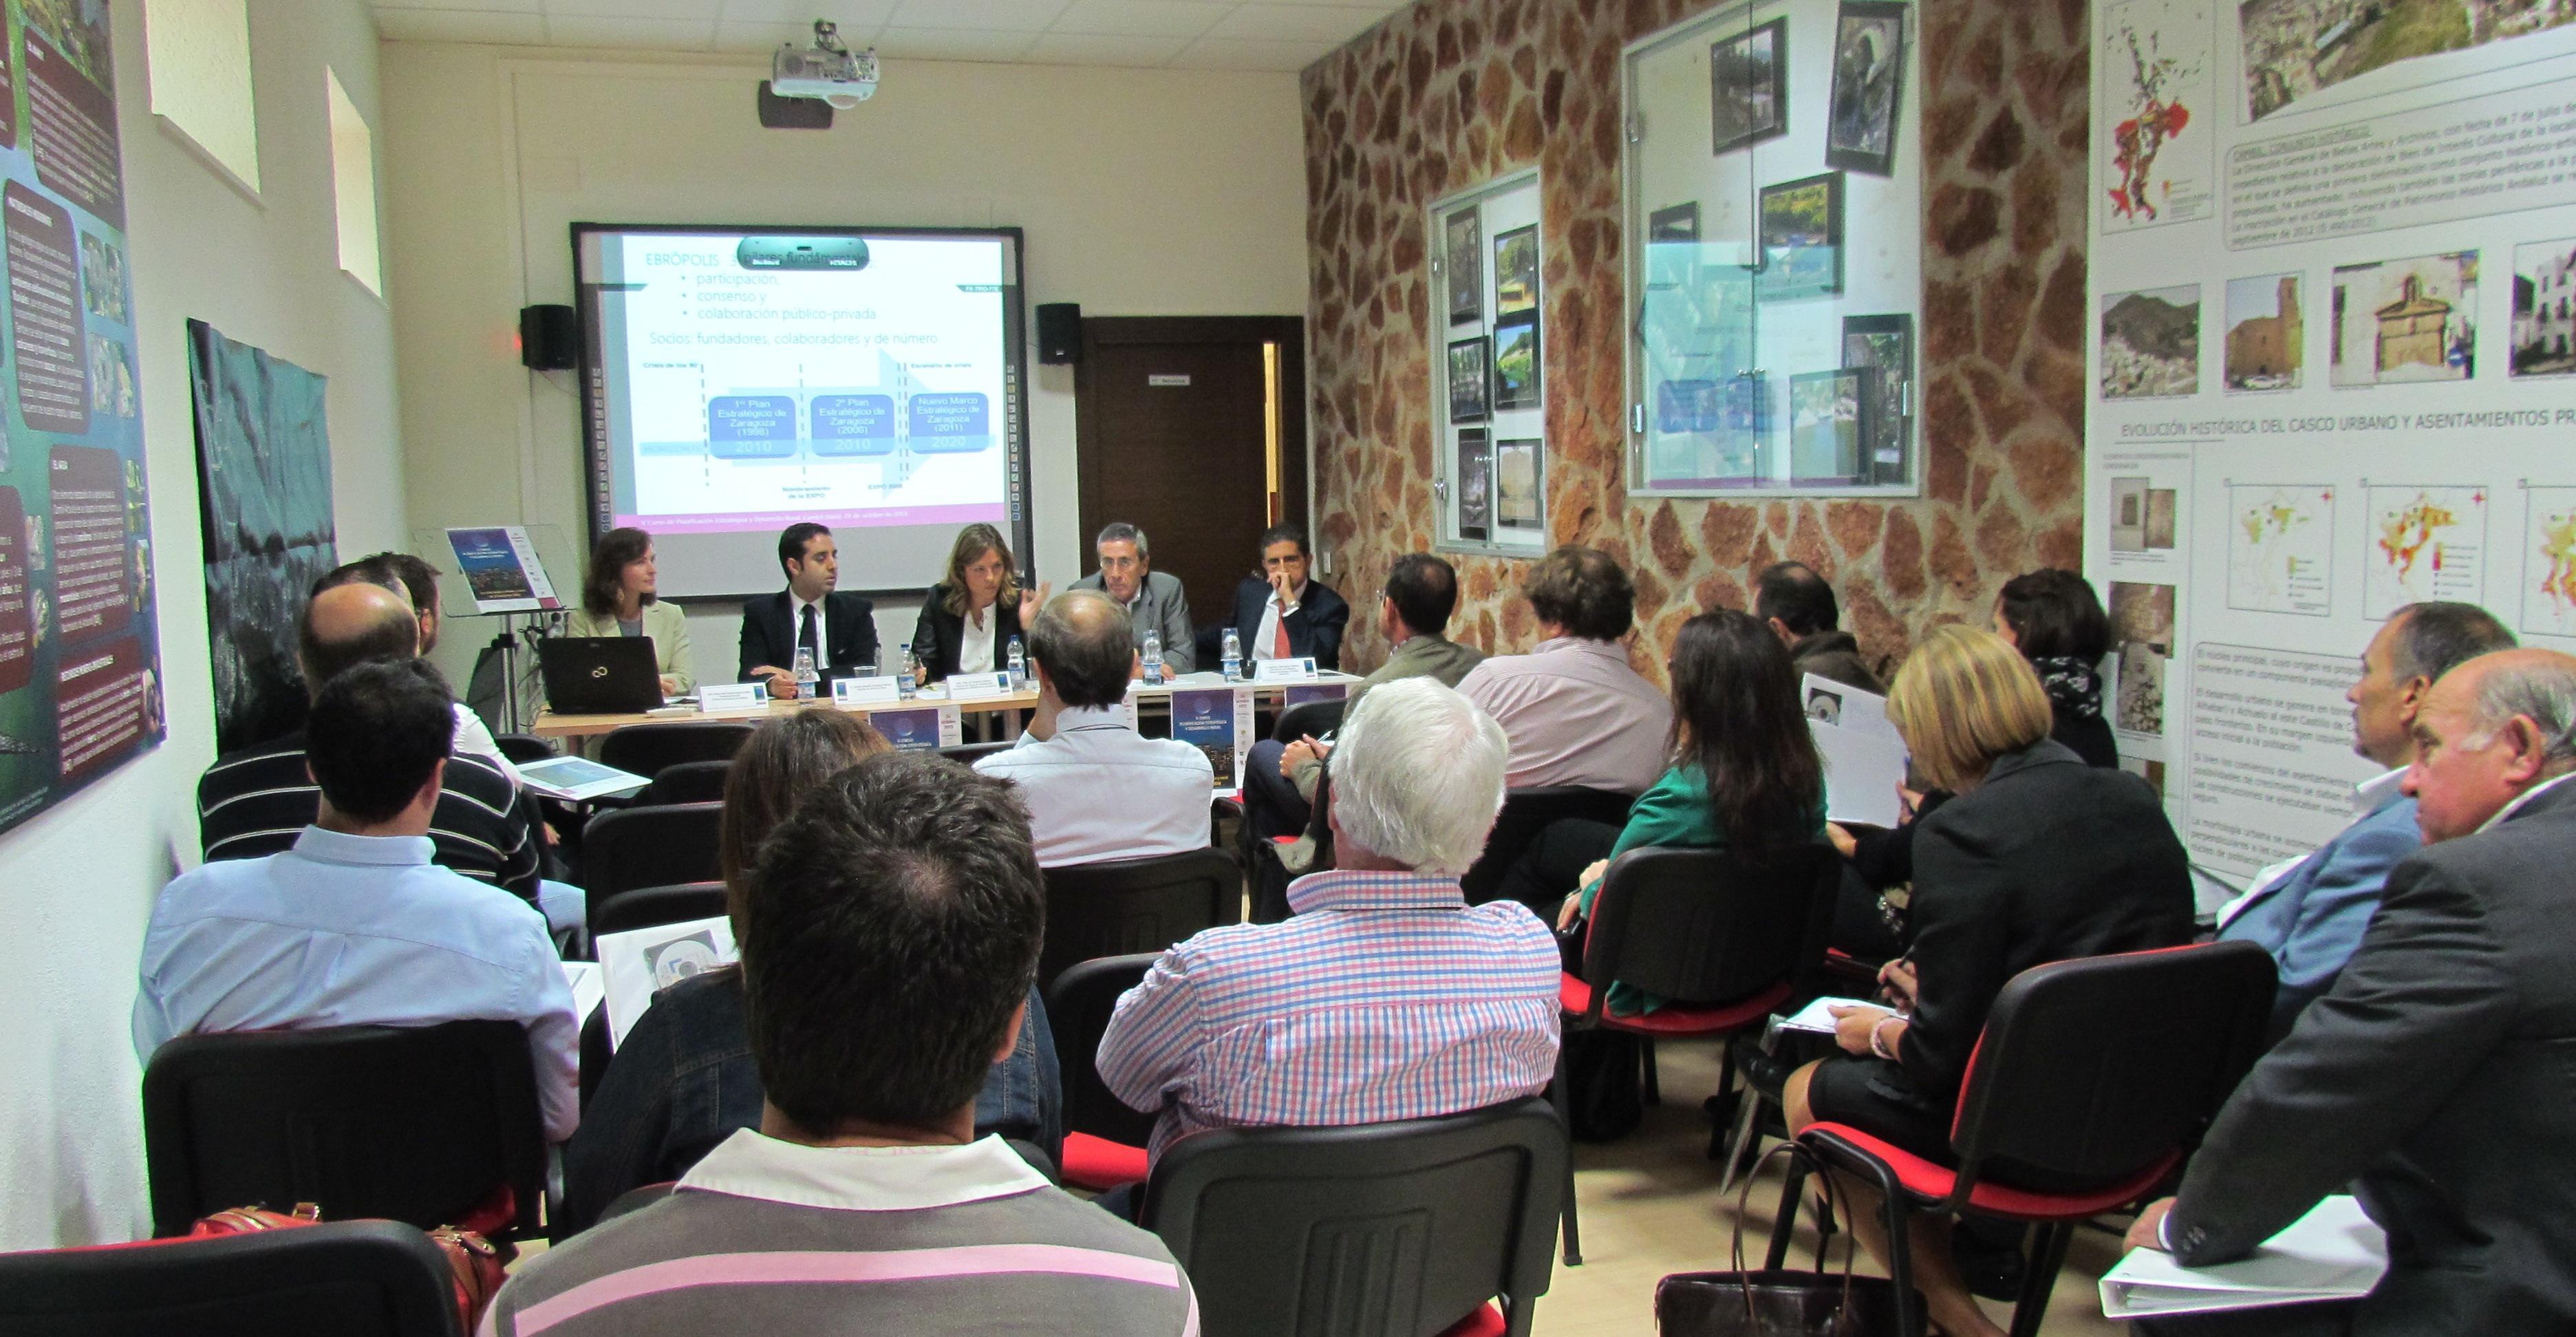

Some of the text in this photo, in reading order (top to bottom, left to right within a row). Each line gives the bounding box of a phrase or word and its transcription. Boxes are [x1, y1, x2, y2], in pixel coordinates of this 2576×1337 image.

[646, 251, 719, 266] EBRÓPOLIS
[697, 292, 767, 306] consenso y
[698, 308, 877, 323] colaboración público-privada
[650, 332, 694, 345] Socios:
[697, 332, 771, 347] fundadores,
[774, 332, 860, 345] colaboradores
[874, 332, 889, 344] de
[892, 331, 938, 344] número
[749, 400, 771, 408] Plan
[848, 398, 870, 407] Plan
[918, 396, 978, 406] Nuevo Marco
[775, 409, 787, 418] de
[874, 407, 886, 416] de
[969, 405, 980, 414] de
[729, 419, 776, 429] Zaragoza
[2121, 418, 2187, 437] EVOLUCIÓN
[2190, 417, 2257, 435] HISTÓRICA
[2261, 418, 2285, 434] DEL
[2288, 417, 2335, 433] CASCO
[2339, 415, 2397, 431] URBANO
[2401, 414, 2411, 429] Y
[2415, 409, 2550, 429] ASENTAMIENTOS
[737, 441, 772, 453] 2010
[836, 439, 870, 451] 2010
